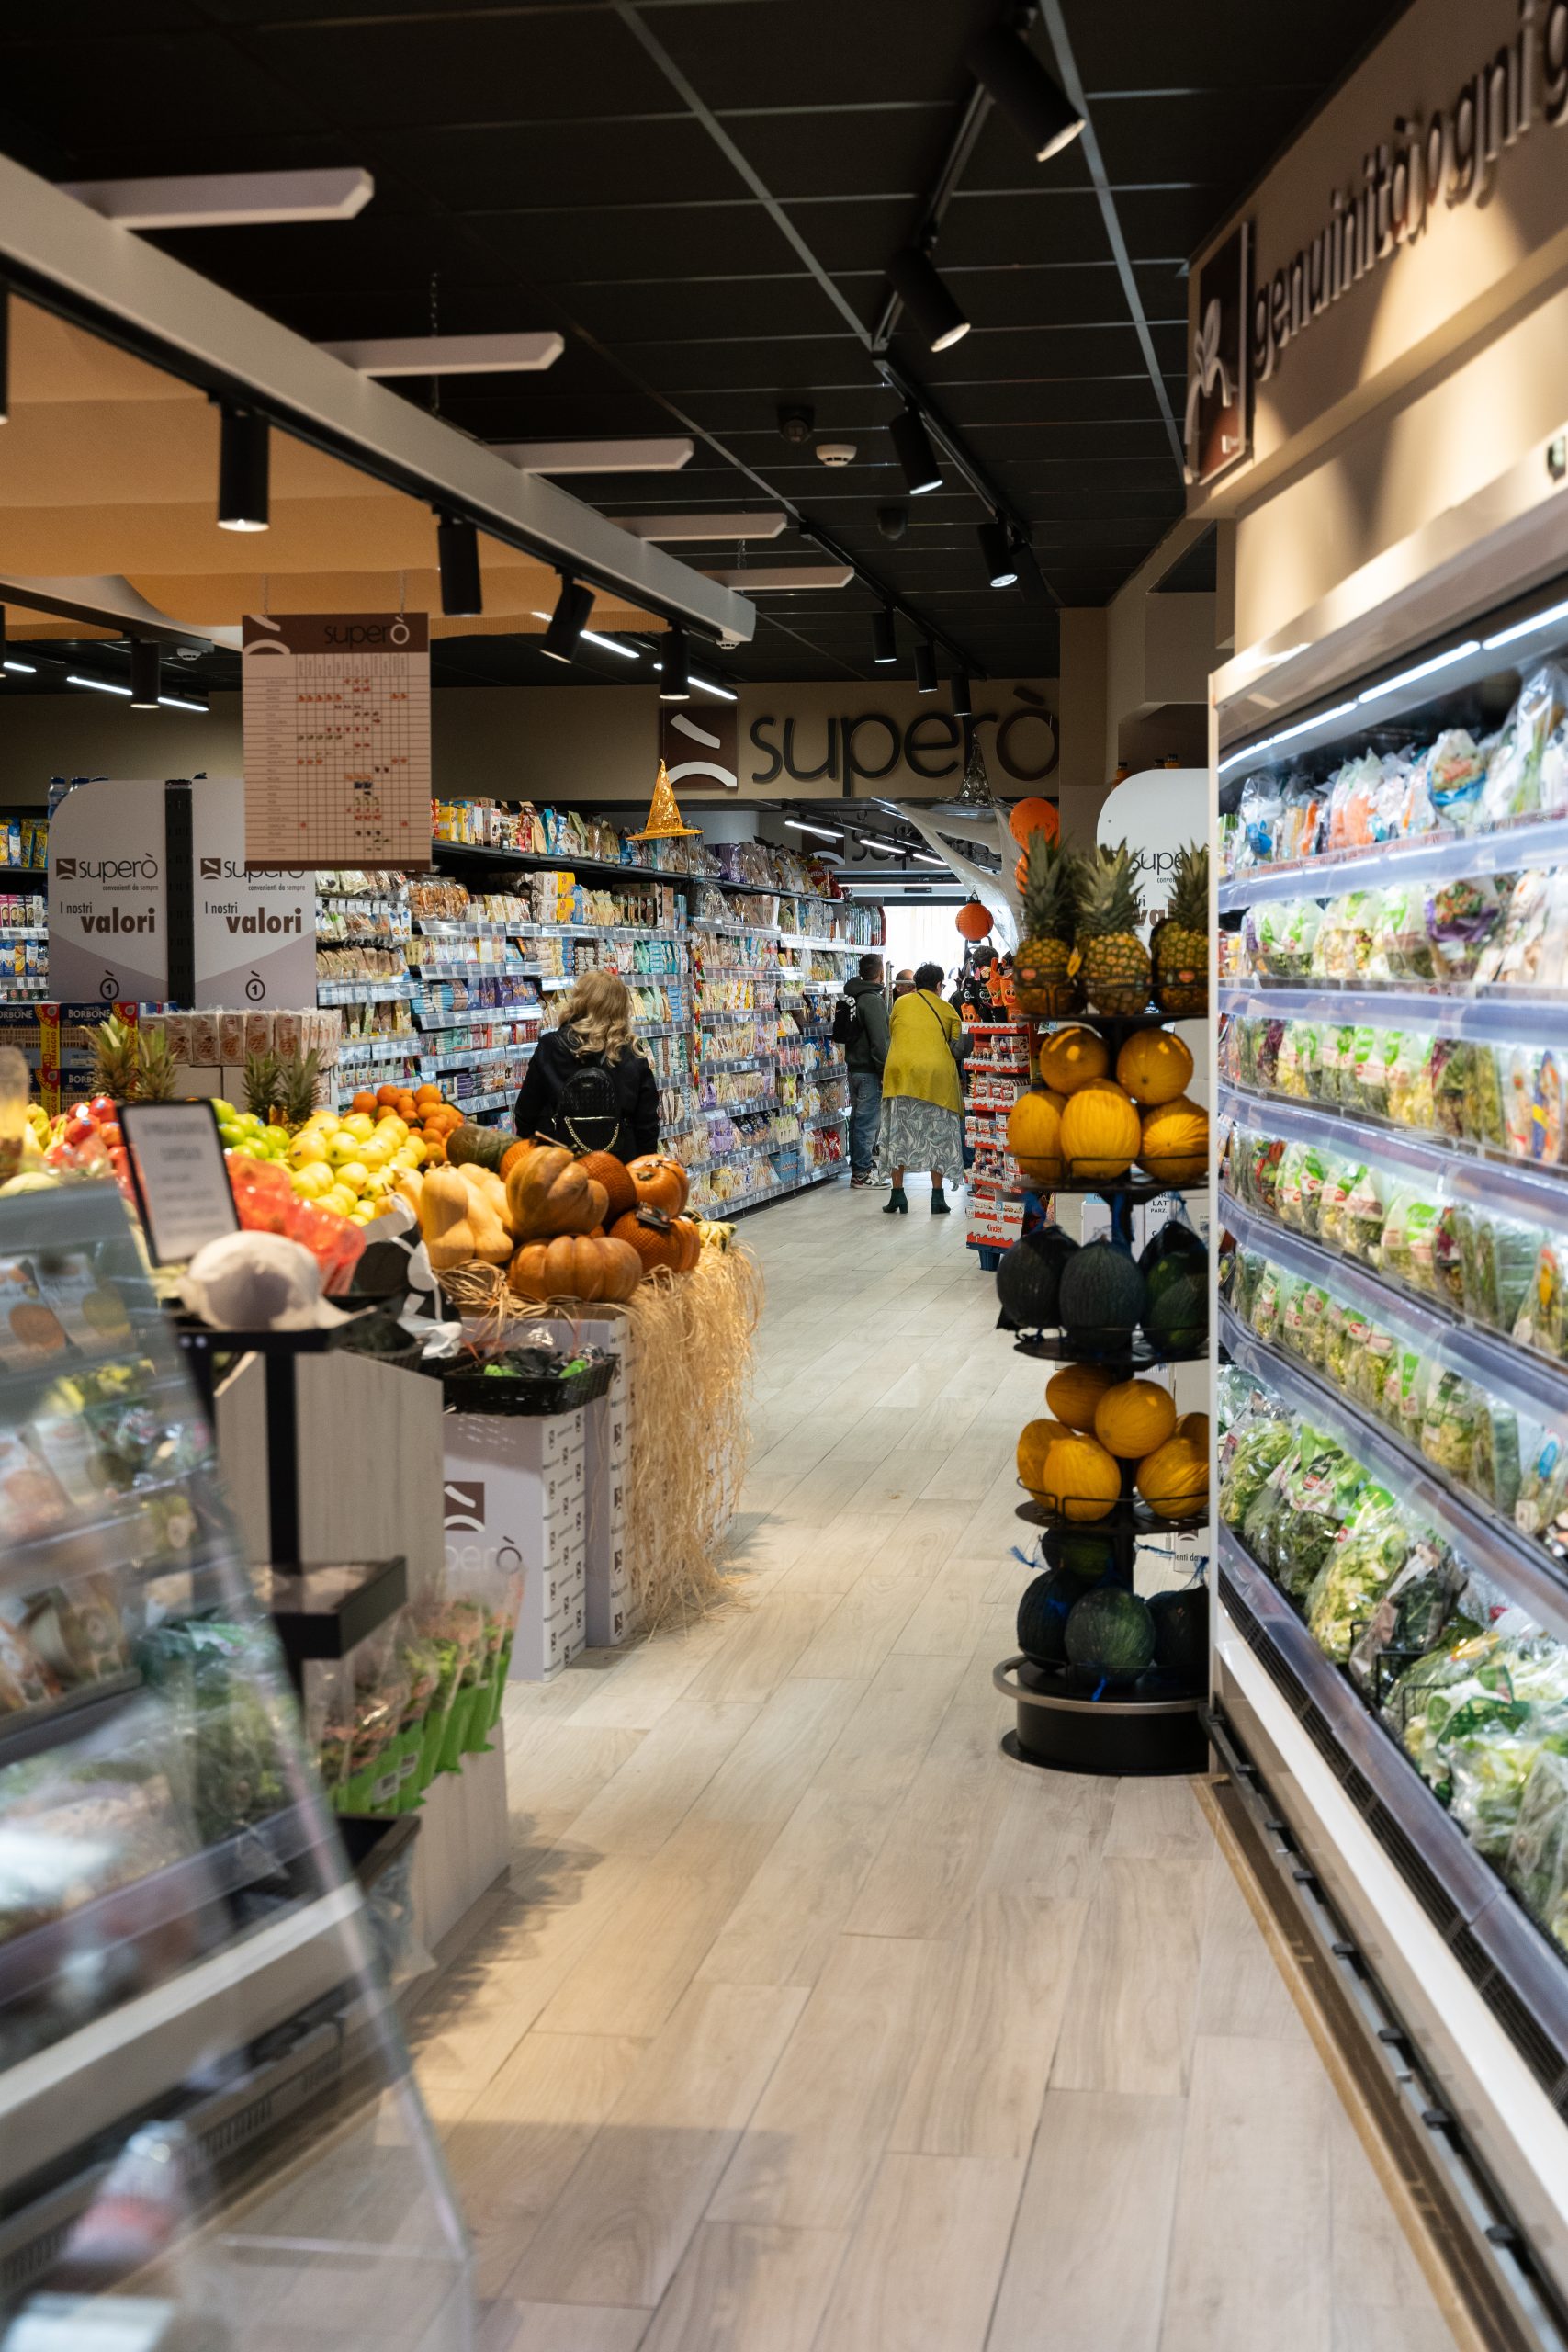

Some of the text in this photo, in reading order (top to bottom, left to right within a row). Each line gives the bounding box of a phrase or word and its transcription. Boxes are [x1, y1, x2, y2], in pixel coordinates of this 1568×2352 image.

[324, 616, 410, 648] superò
[750, 686, 1059, 797] superò
[79, 853, 158, 883] superò
[1132, 852, 1190, 875] supe
[66, 901, 93, 914] nostri
[211, 901, 238, 914] nostri
[81, 906, 156, 933] valori
[225, 906, 302, 933] valori
[68, 1009, 111, 1019] BORBONE
[68, 1074, 98, 1084] BORBO
[986, 1222, 1003, 1233] Kinder
